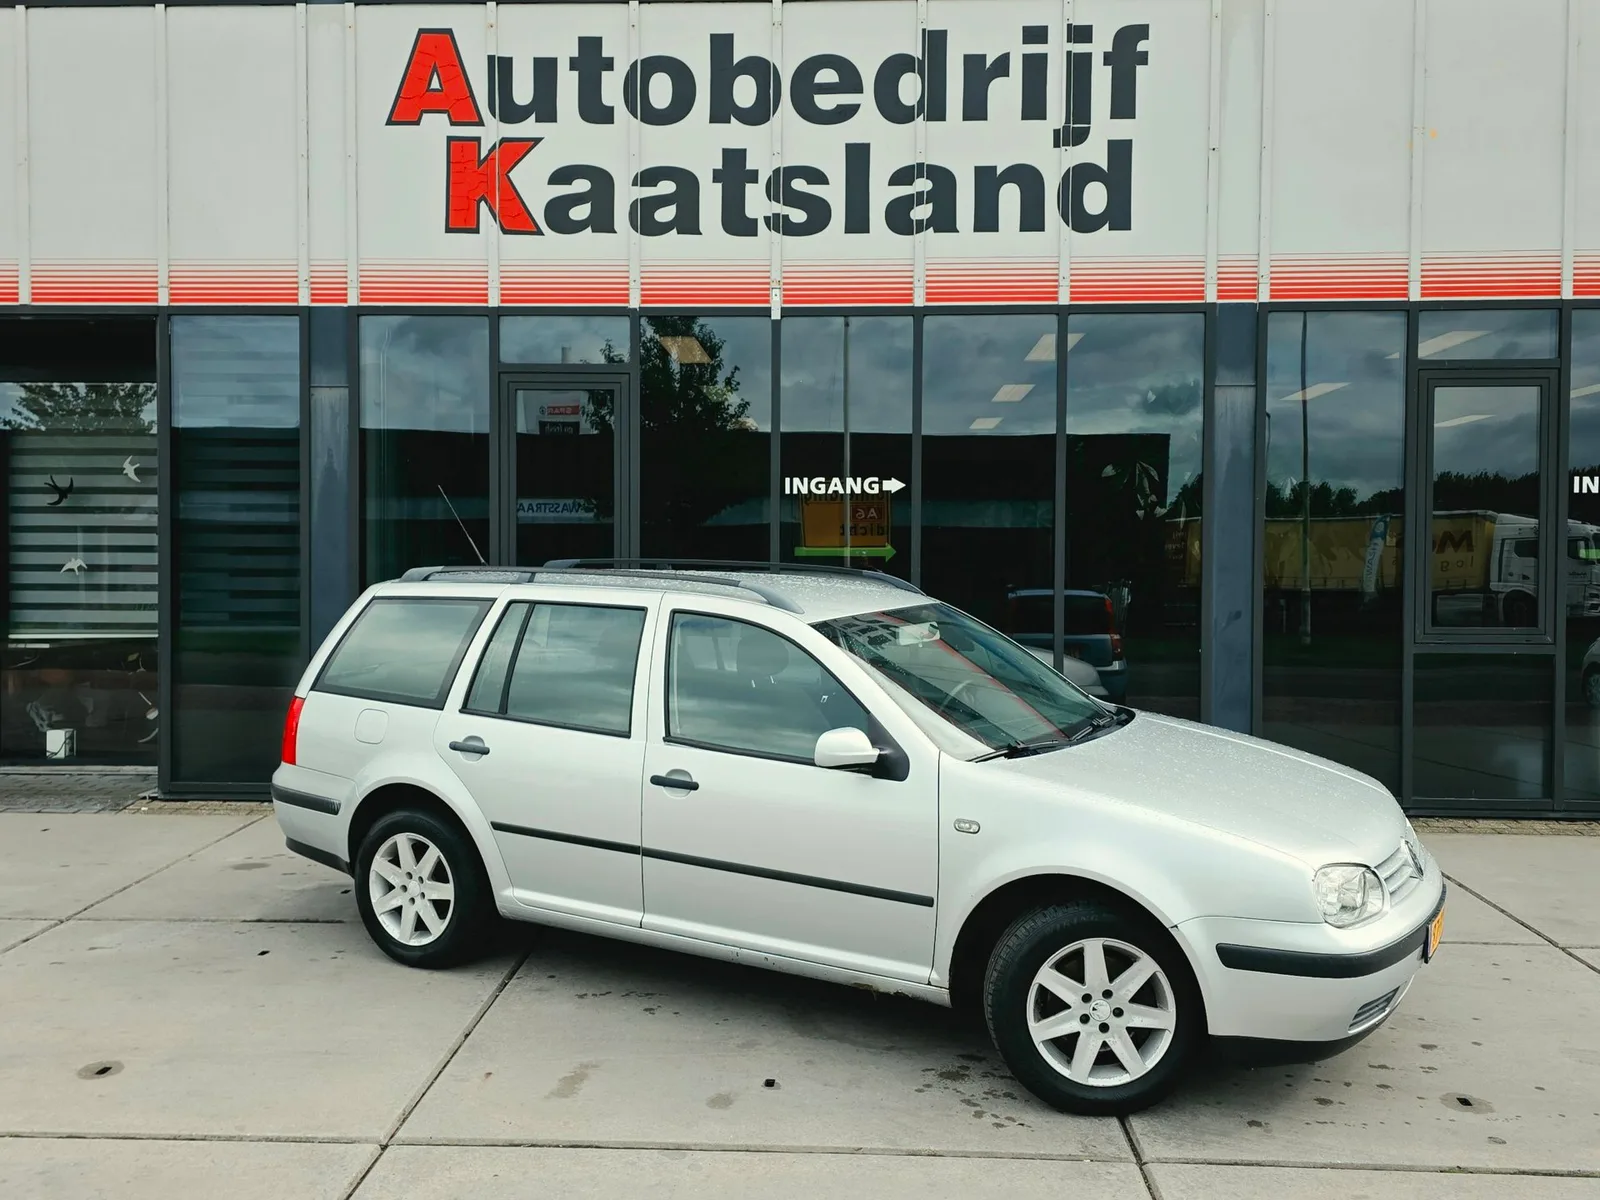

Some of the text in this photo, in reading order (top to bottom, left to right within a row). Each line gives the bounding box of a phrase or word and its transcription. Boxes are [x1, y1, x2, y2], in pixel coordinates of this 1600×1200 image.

[386, 24, 1149, 147] Autobedrijf
[445, 137, 1132, 236] Kaatsland
[785, 477, 880, 494] INGANG
[1574, 476, 1600, 493] IN
